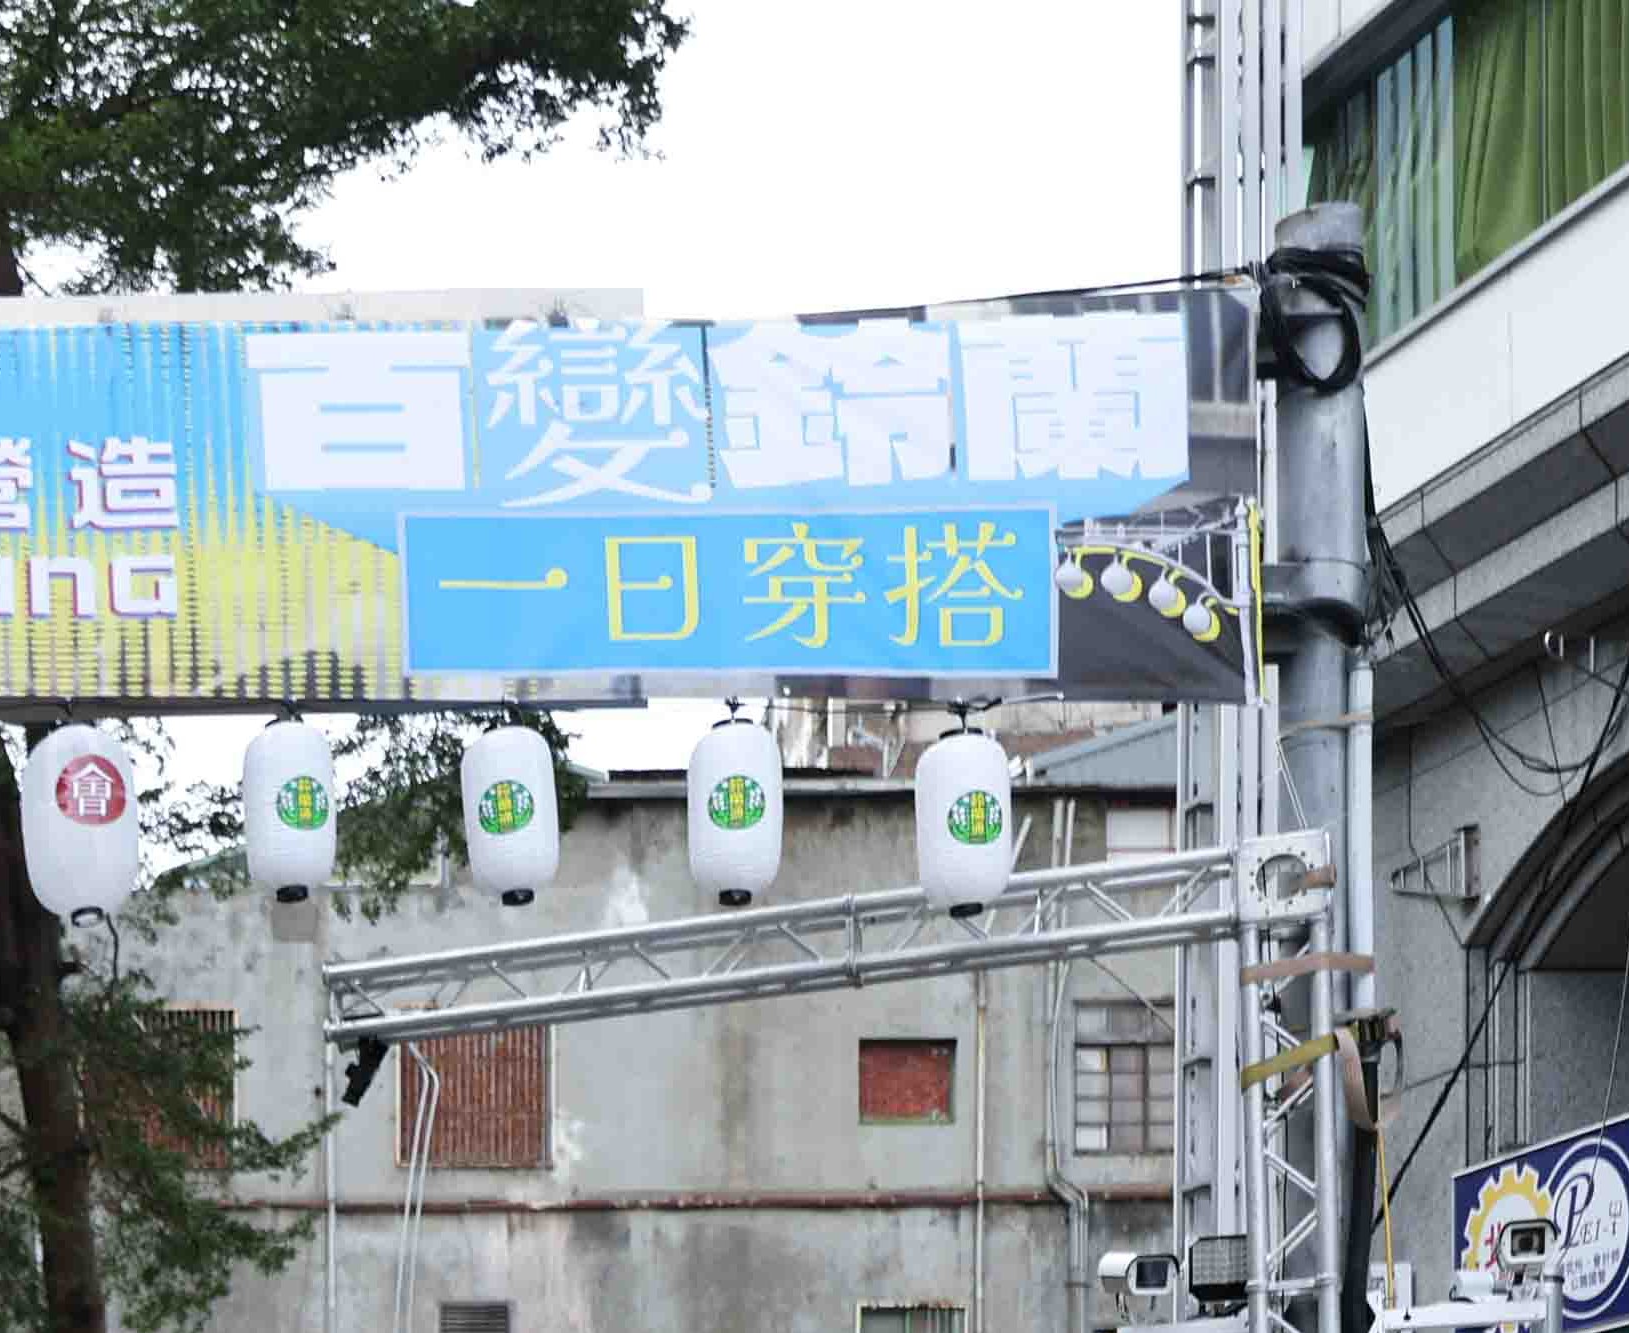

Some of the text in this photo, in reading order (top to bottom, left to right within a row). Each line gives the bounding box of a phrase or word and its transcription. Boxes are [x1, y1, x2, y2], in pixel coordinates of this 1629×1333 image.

[245, 312, 1189, 508] 百變鈴蘭
[436, 521, 1024, 650] 一日穿搭
